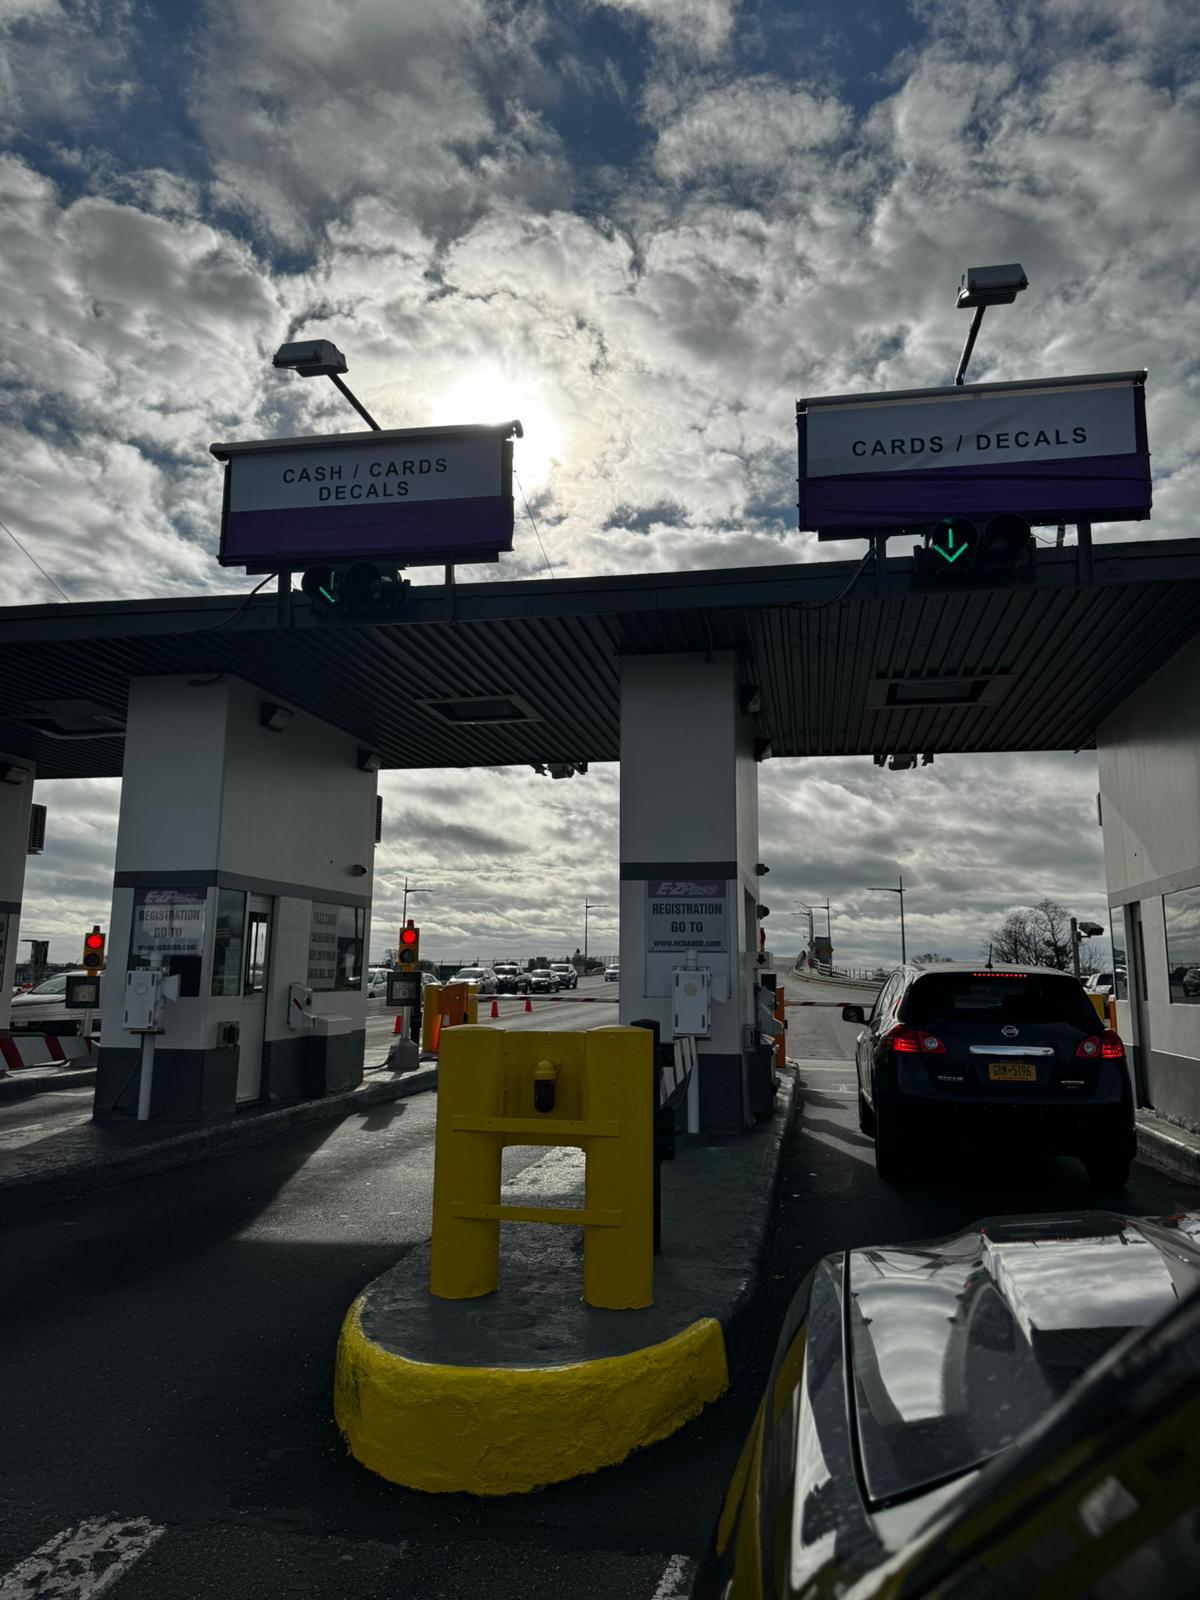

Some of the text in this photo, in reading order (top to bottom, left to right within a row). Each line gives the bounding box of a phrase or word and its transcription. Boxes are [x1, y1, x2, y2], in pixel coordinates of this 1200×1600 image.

[852, 427, 1088, 457] CARDS / DECALS
[283, 458, 448, 484] CASH / CARDS
[319, 481, 409, 502] DECALS
[139, 910, 200, 921] REGISTRATION
[652, 903, 722, 915] REGISTRATION
[154, 927, 182, 938] GO TO
[671, 920, 704, 933] GO TO
